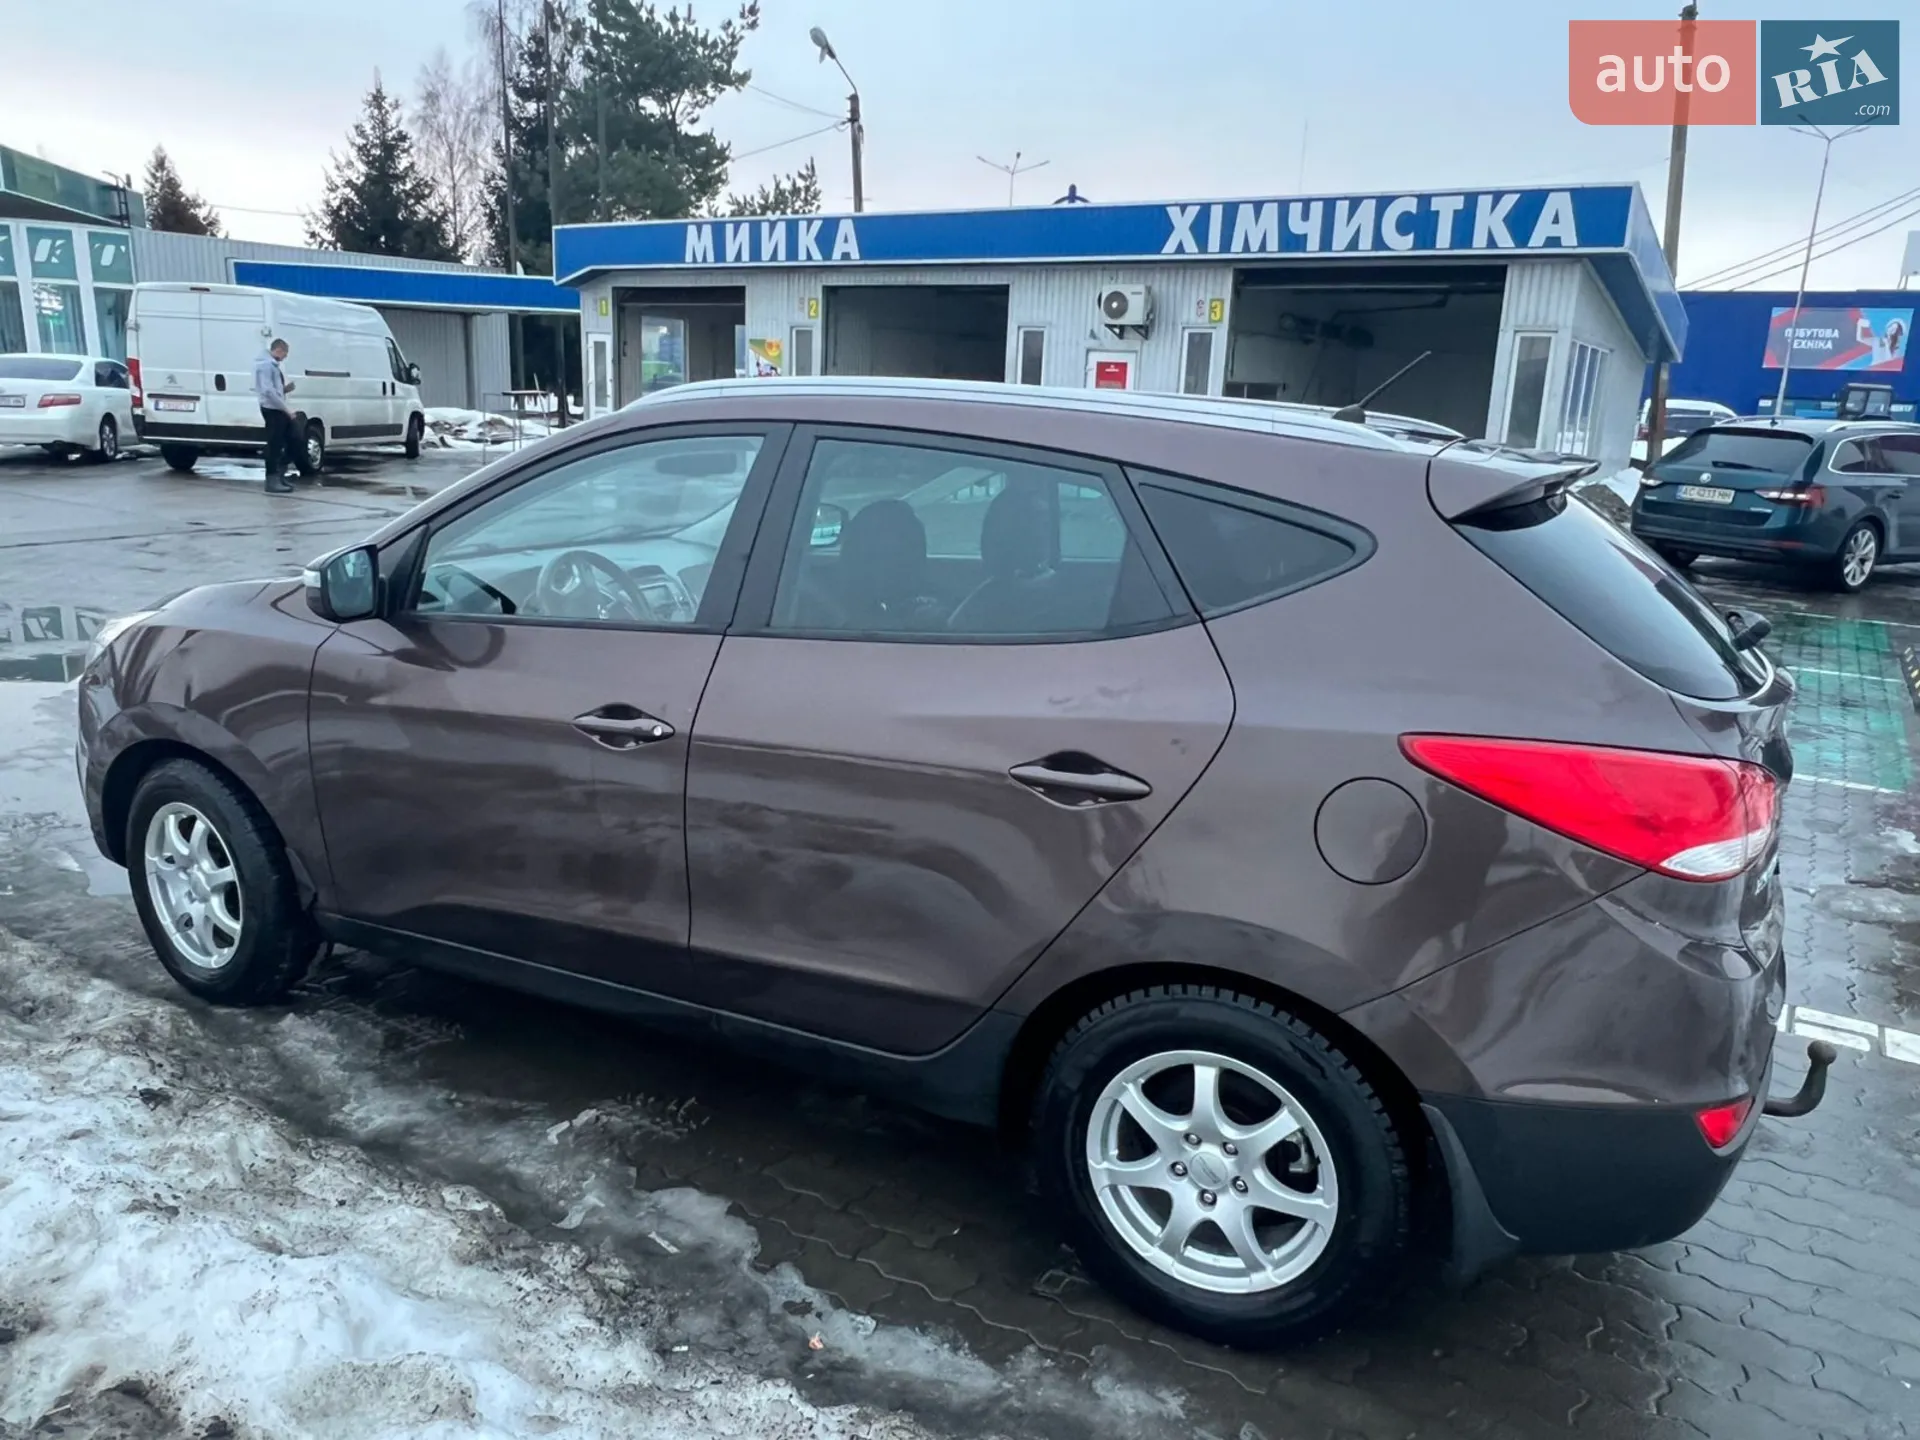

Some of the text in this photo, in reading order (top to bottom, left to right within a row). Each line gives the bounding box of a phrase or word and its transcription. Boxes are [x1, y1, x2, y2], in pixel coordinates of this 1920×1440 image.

[1161, 190, 1578, 255] ХІМЧИСТКА
[684, 215, 861, 264] МИЙКА
[809, 299, 817, 317] 2
[1210, 300, 1222, 321] 3
[1787, 338, 1833, 350] ЕХНІКА
